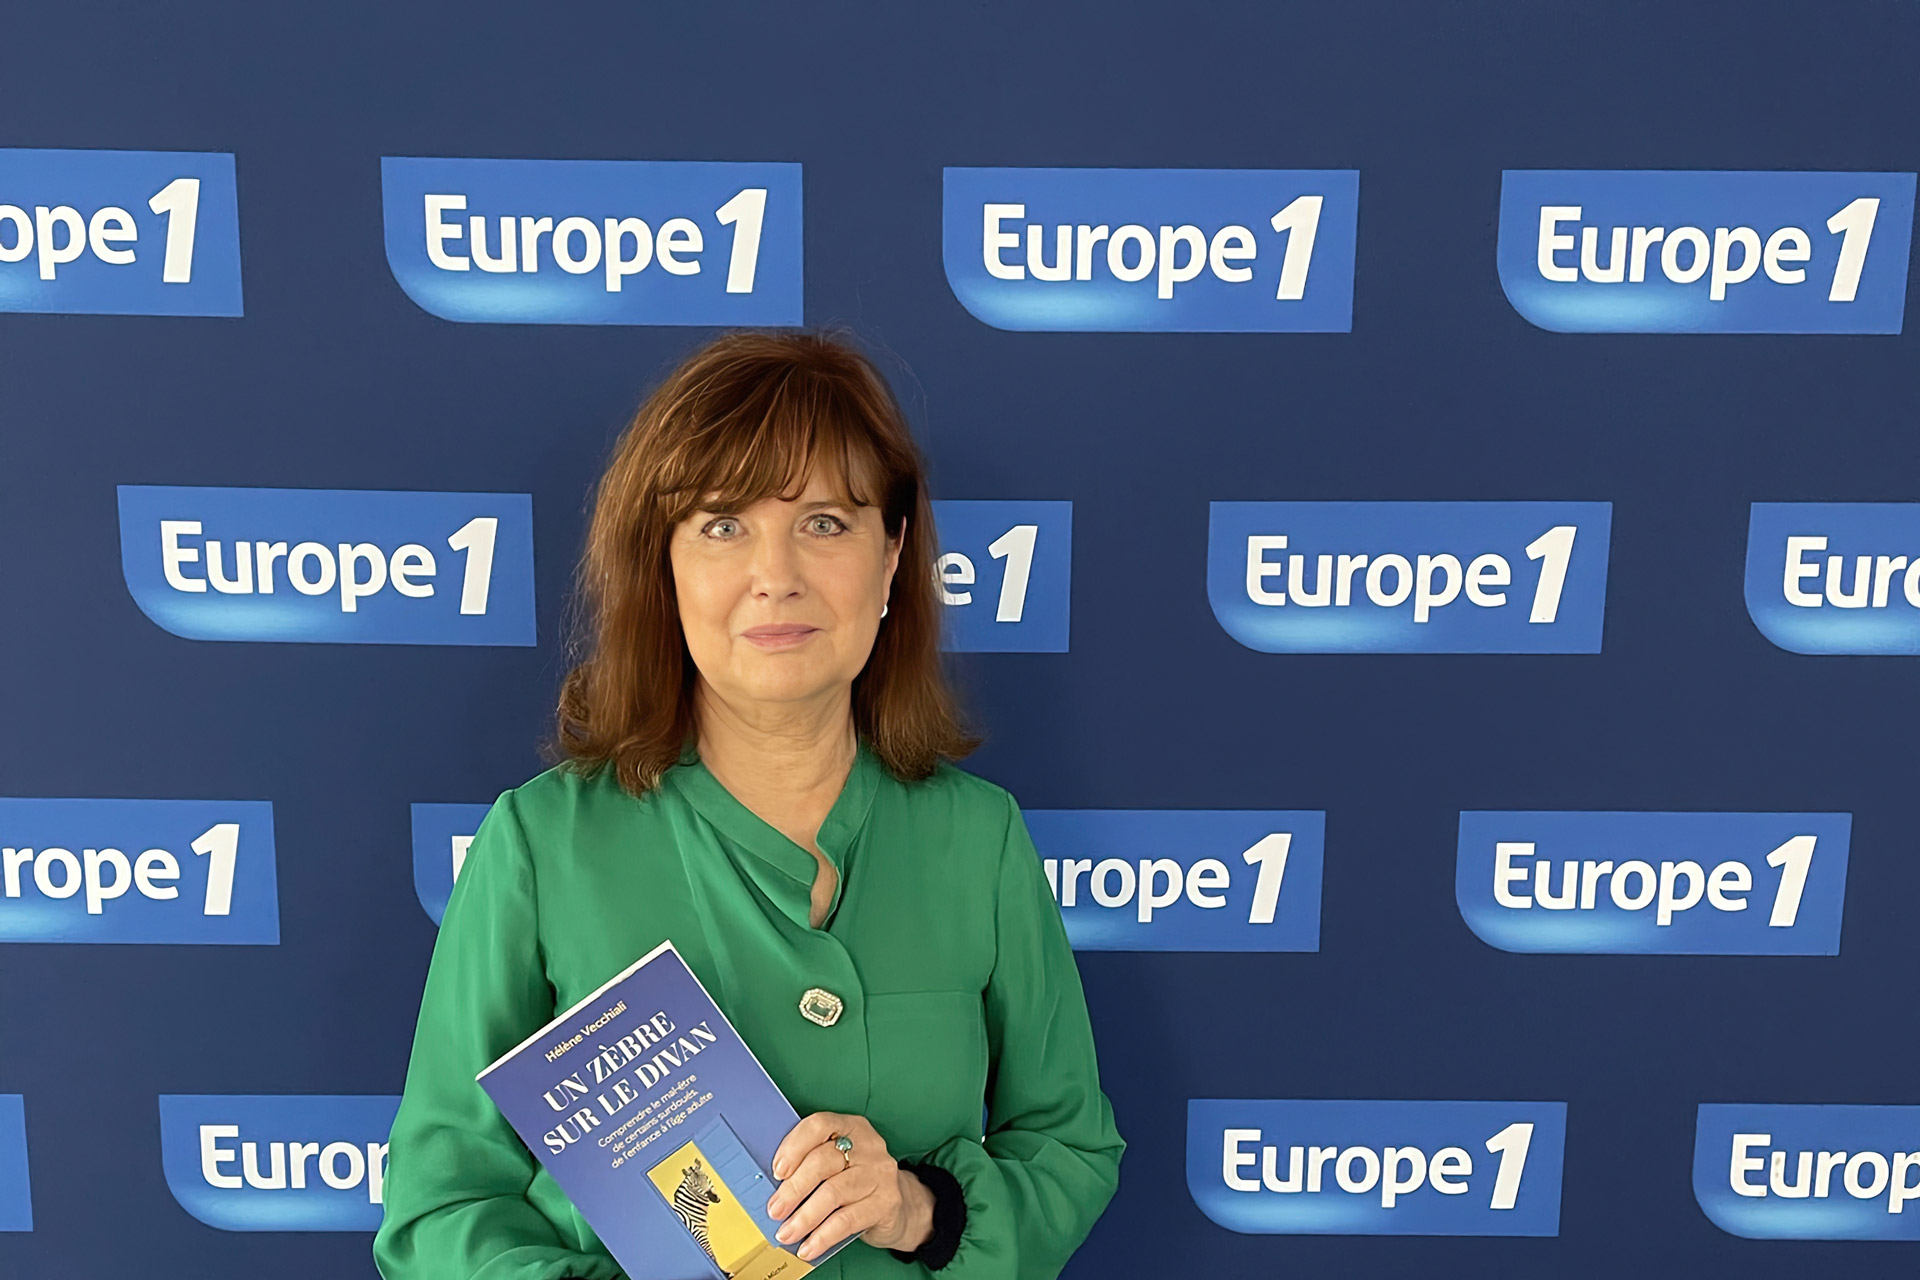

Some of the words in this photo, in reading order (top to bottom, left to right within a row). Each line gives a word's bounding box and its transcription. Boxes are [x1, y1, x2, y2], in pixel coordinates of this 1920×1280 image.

[0, 205, 137, 281] ope
[149, 178, 200, 283] 1
[424, 194, 704, 294] Europe
[715, 188, 768, 294] 1
[983, 203, 1257, 300] Europe
[1270, 195, 1324, 300] 1
[1537, 206, 1811, 302] Europe
[1826, 198, 1881, 302] 1
[160, 520, 437, 613] Europe
[447, 517, 498, 615] 1
[988, 525, 1038, 622] 1
[1246, 535, 1511, 623] Europe
[1525, 526, 1577, 623] 1
[2, 847, 180, 915] rope
[190, 823, 240, 916] 1
[1242, 833, 1292, 924] 1
[1493, 842, 1752, 926] Europe
[1766, 835, 1818, 927] 1
[543, 1072, 589, 1112] UN
[585, 1011, 676, 1084] ZÈBRE
[544, 1034, 583, 1063] Hélène
[580, 1000, 628, 1037] Vecchiali
[543, 1107, 602, 1155] SUR
[597, 1078, 639, 1116] LE
[634, 1021, 717, 1090] DIVAN
[598, 1108, 653, 1148] Comprendre
[650, 1099, 662, 1109] le
[611, 1157, 625, 1169] de
[622, 1129, 662, 1160] l'enfance
[659, 1123, 669, 1133] à
[686, 1092, 714, 1113] adulte
[612, 1141, 625, 1153] de
[624, 1116, 659, 1144] certains
[1222, 1129, 1473, 1208] Europe
[1485, 1123, 1534, 1209] 1
